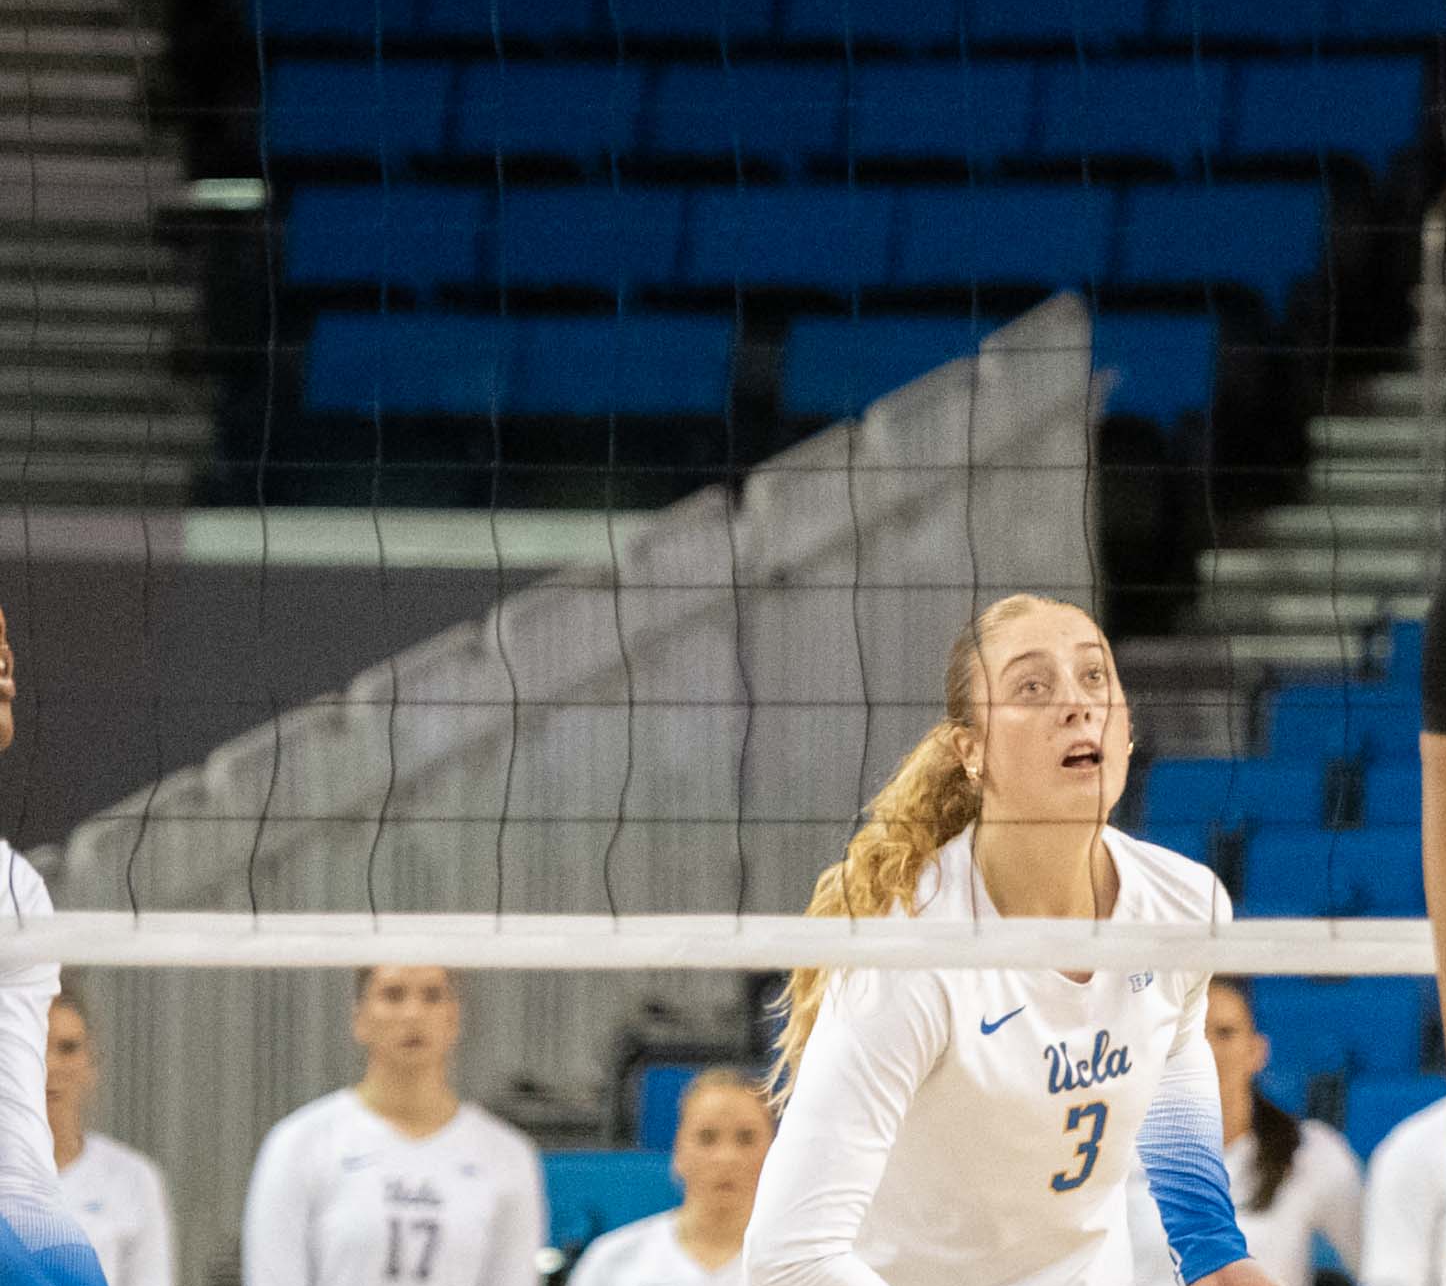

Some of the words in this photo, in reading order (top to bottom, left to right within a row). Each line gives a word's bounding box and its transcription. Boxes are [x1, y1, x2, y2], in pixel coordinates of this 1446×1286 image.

[1043, 1029, 1132, 1094] Ucla
[1049, 1099, 1110, 1193] 3
[383, 1218, 440, 1283] 17
